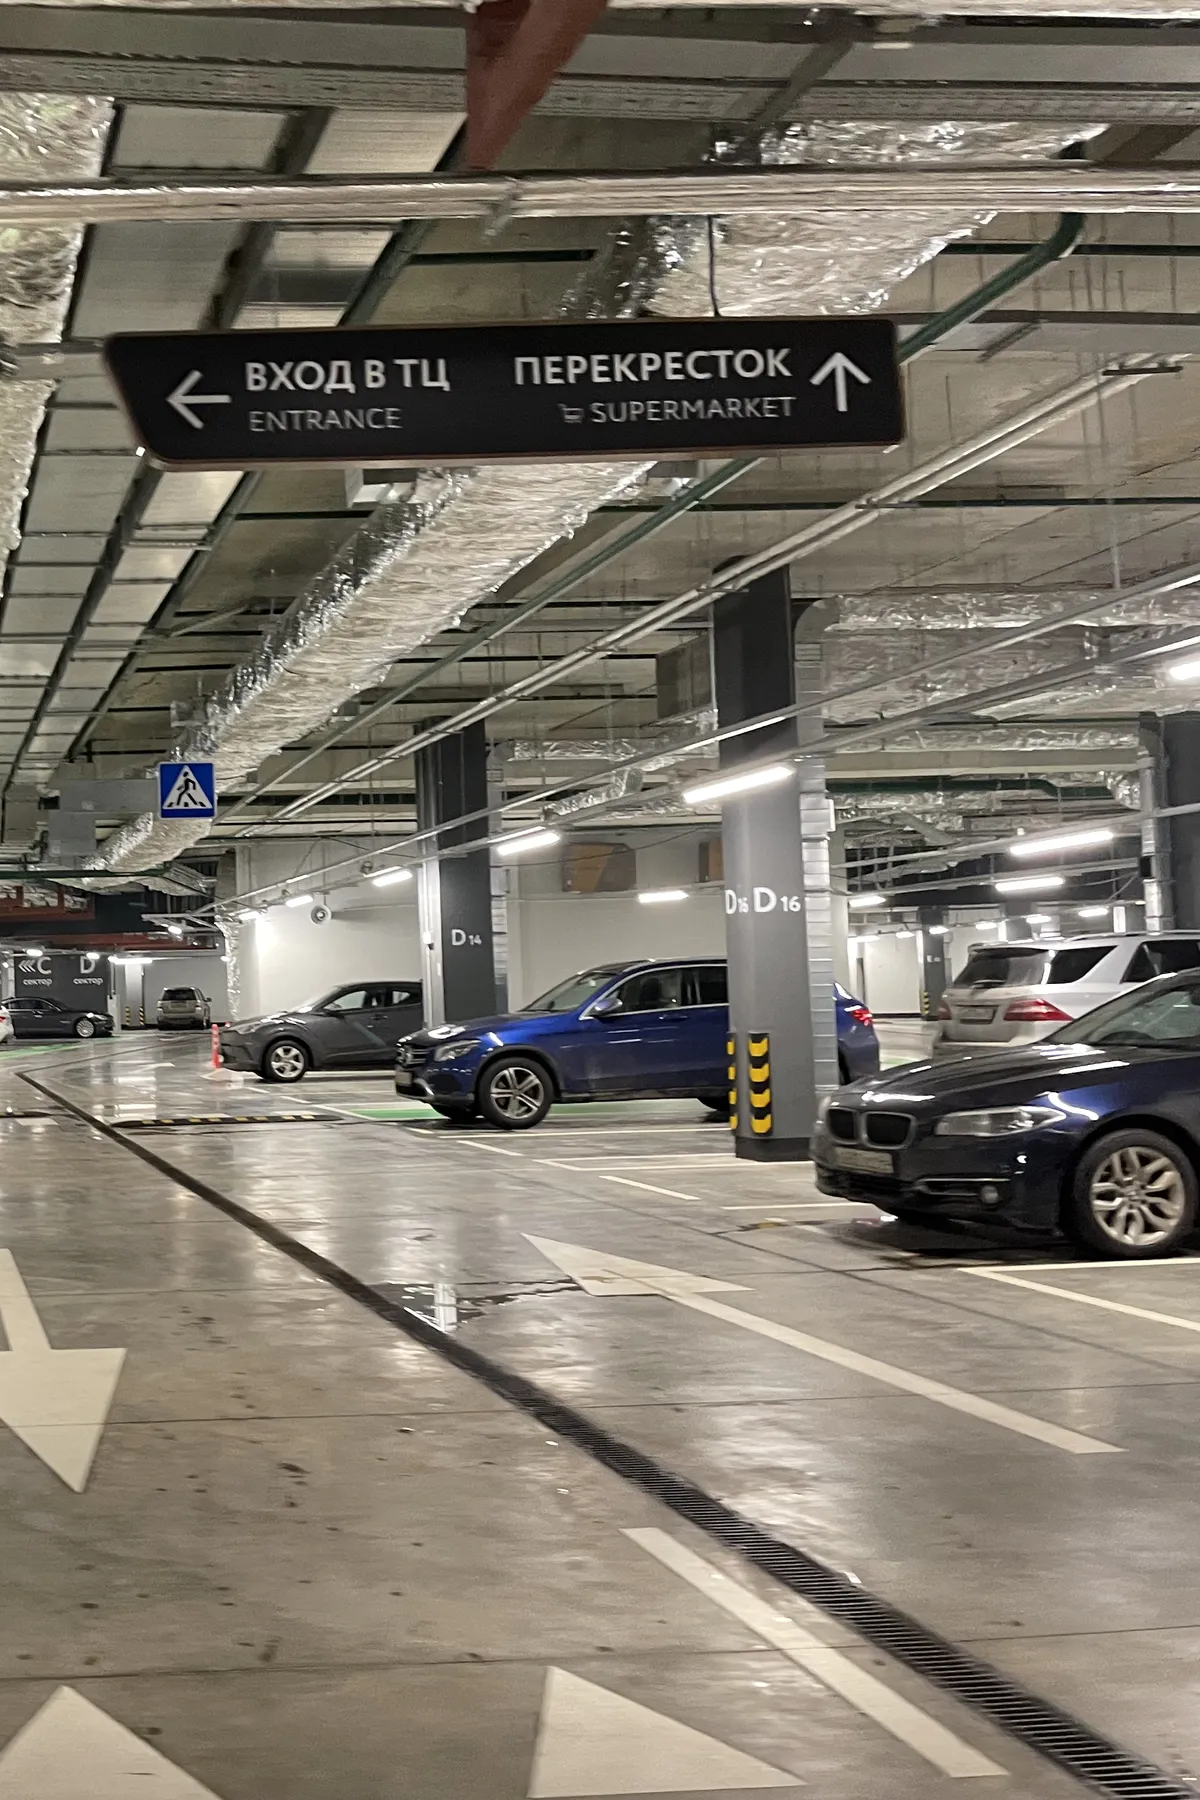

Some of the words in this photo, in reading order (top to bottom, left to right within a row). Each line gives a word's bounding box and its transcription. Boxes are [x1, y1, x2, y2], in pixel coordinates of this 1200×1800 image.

[244, 361, 355, 393] ВХОД
[365, 361, 385, 389] В
[393, 358, 451, 391] ТЦ
[514, 348, 793, 387] ПЕРЕКРЕСТОК
[249, 407, 403, 434] ENTRANCE
[590, 396, 796, 425] SUPERMARKET
[79, 955, 96, 974] D
